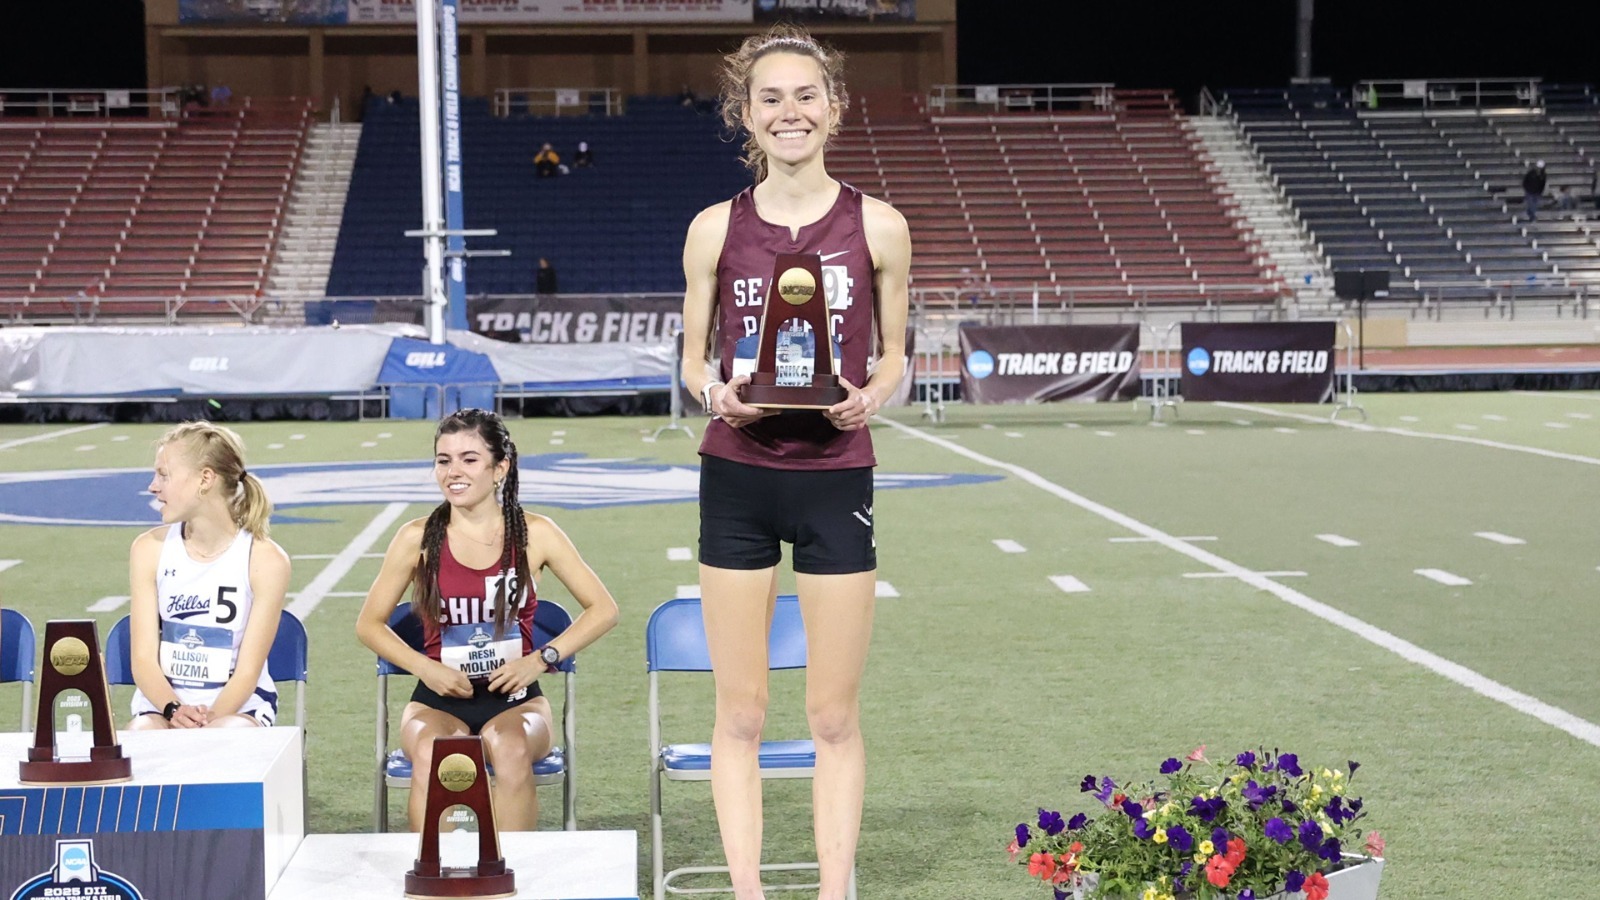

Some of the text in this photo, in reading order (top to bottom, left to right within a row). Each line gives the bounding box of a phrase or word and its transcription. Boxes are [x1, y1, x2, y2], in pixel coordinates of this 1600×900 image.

[476, 312, 682, 343] TRACK & FIELD
[188, 357, 230, 371] GILL
[405, 352, 447, 368] GILL
[997, 351, 1134, 375] TRACK & FIELD
[1212, 350, 1329, 374] TRACK & FIELD
[215, 586, 238, 624] 5
[172, 650, 209, 662] ALLISON
[468, 648, 496, 661] IRESH
[170, 663, 209, 679] KUZMA
[460, 657, 506, 674] MOLINA
[44, 887, 107, 897] 2025 DII
